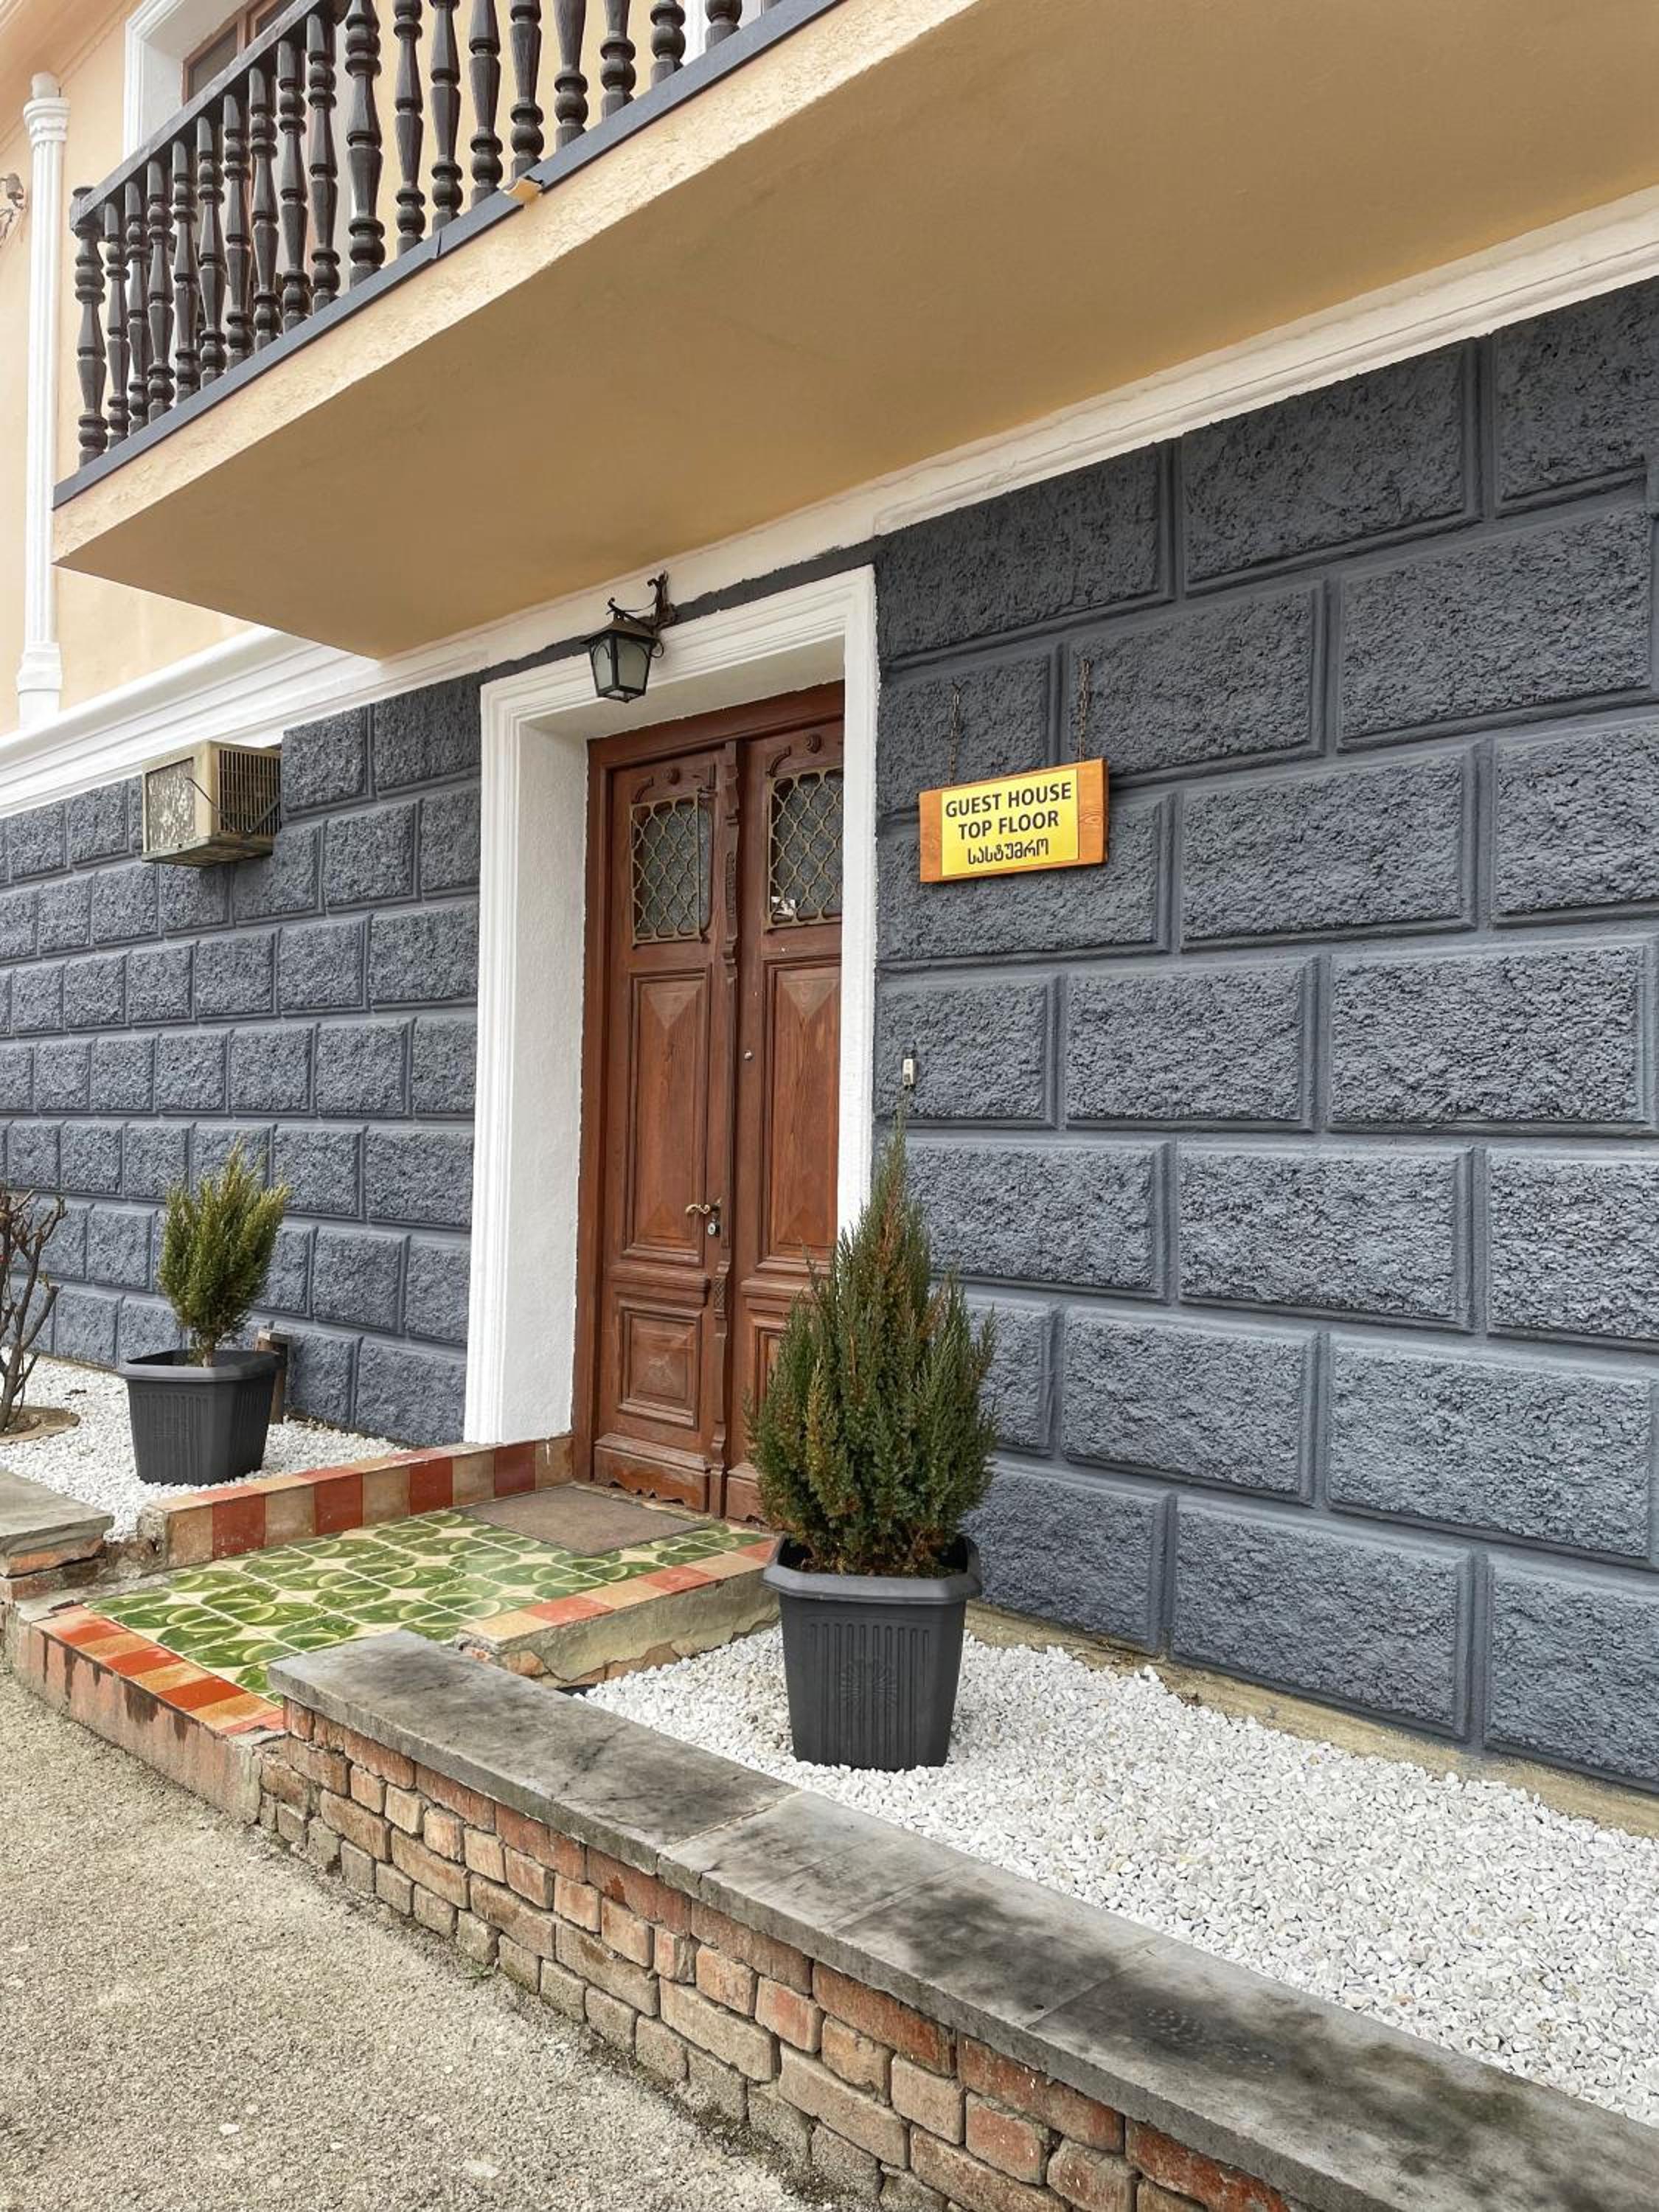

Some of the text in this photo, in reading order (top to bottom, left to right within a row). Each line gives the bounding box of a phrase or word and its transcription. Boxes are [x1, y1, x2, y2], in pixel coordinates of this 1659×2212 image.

[945, 782, 1071, 818] GUEST HOUSE
[959, 810, 1059, 840] TOP FLOOR
[967, 838, 1048, 865] სასტუმრო
